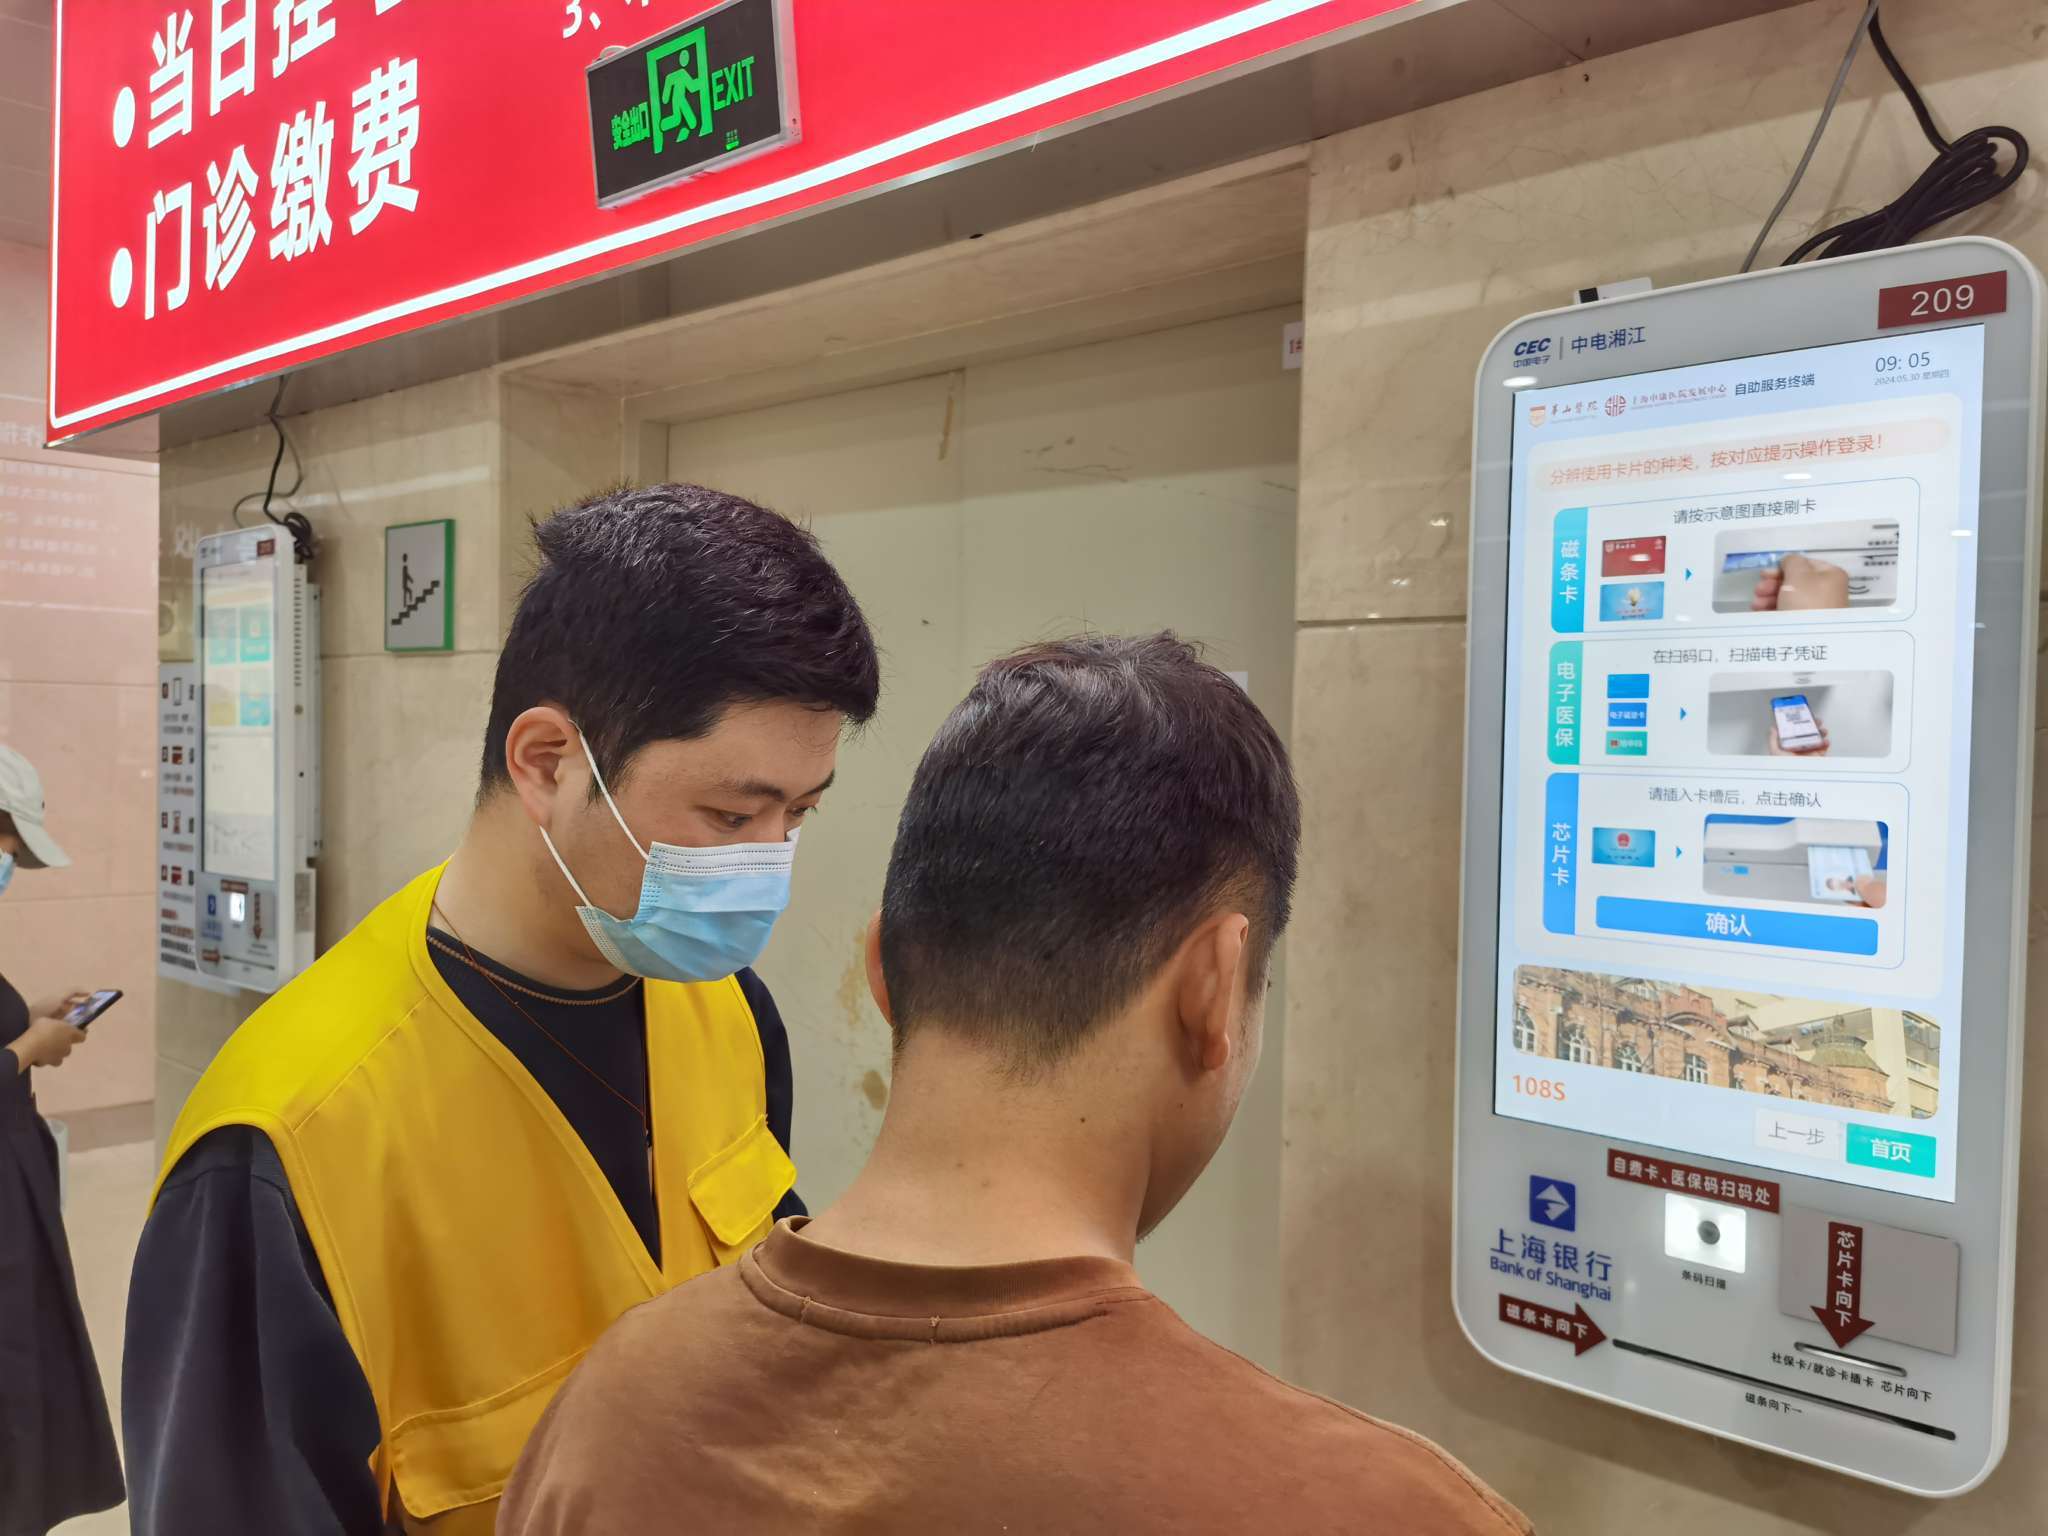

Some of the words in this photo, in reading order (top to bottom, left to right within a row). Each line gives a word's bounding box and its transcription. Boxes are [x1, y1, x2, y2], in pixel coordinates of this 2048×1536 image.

[711, 55, 755, 112] EXIT
[611, 101, 650, 151] 安全出口
[145, 57, 420, 320] 门诊缴费
[1910, 284, 1976, 317] 209
[1514, 338, 1551, 356] CEC
[1571, 326, 1646, 354] 中电湘江
[1735, 373, 1815, 396] 自助服务终端
[1673, 498, 1817, 524] 请按示意图直接刷卡
[1560, 539, 1581, 605] 磁条卡
[1555, 662, 1576, 748] 电子医保
[1552, 822, 1572, 887] 芯片卡
[1705, 912, 1752, 937] 确认
[1512, 1074, 1566, 1101] 108S
[1768, 1120, 1825, 1146] 上一步
[1870, 1138, 1912, 1162] 首页
[1613, 1156, 1771, 1206] 自费卡、医保码扫码处
[1490, 1228, 1612, 1282] 上海银行
[1490, 1257, 1524, 1278] Bank
[1527, 1267, 1542, 1282] of
[1546, 1271, 1611, 1301] Shanghai
[1681, 1270, 1727, 1290] 条码扫描
[1835, 1231, 1855, 1326] 芯片卡向下
[1506, 1303, 1588, 1338] 磁条卡向下
[1881, 1380, 1932, 1402] 芯片向下
